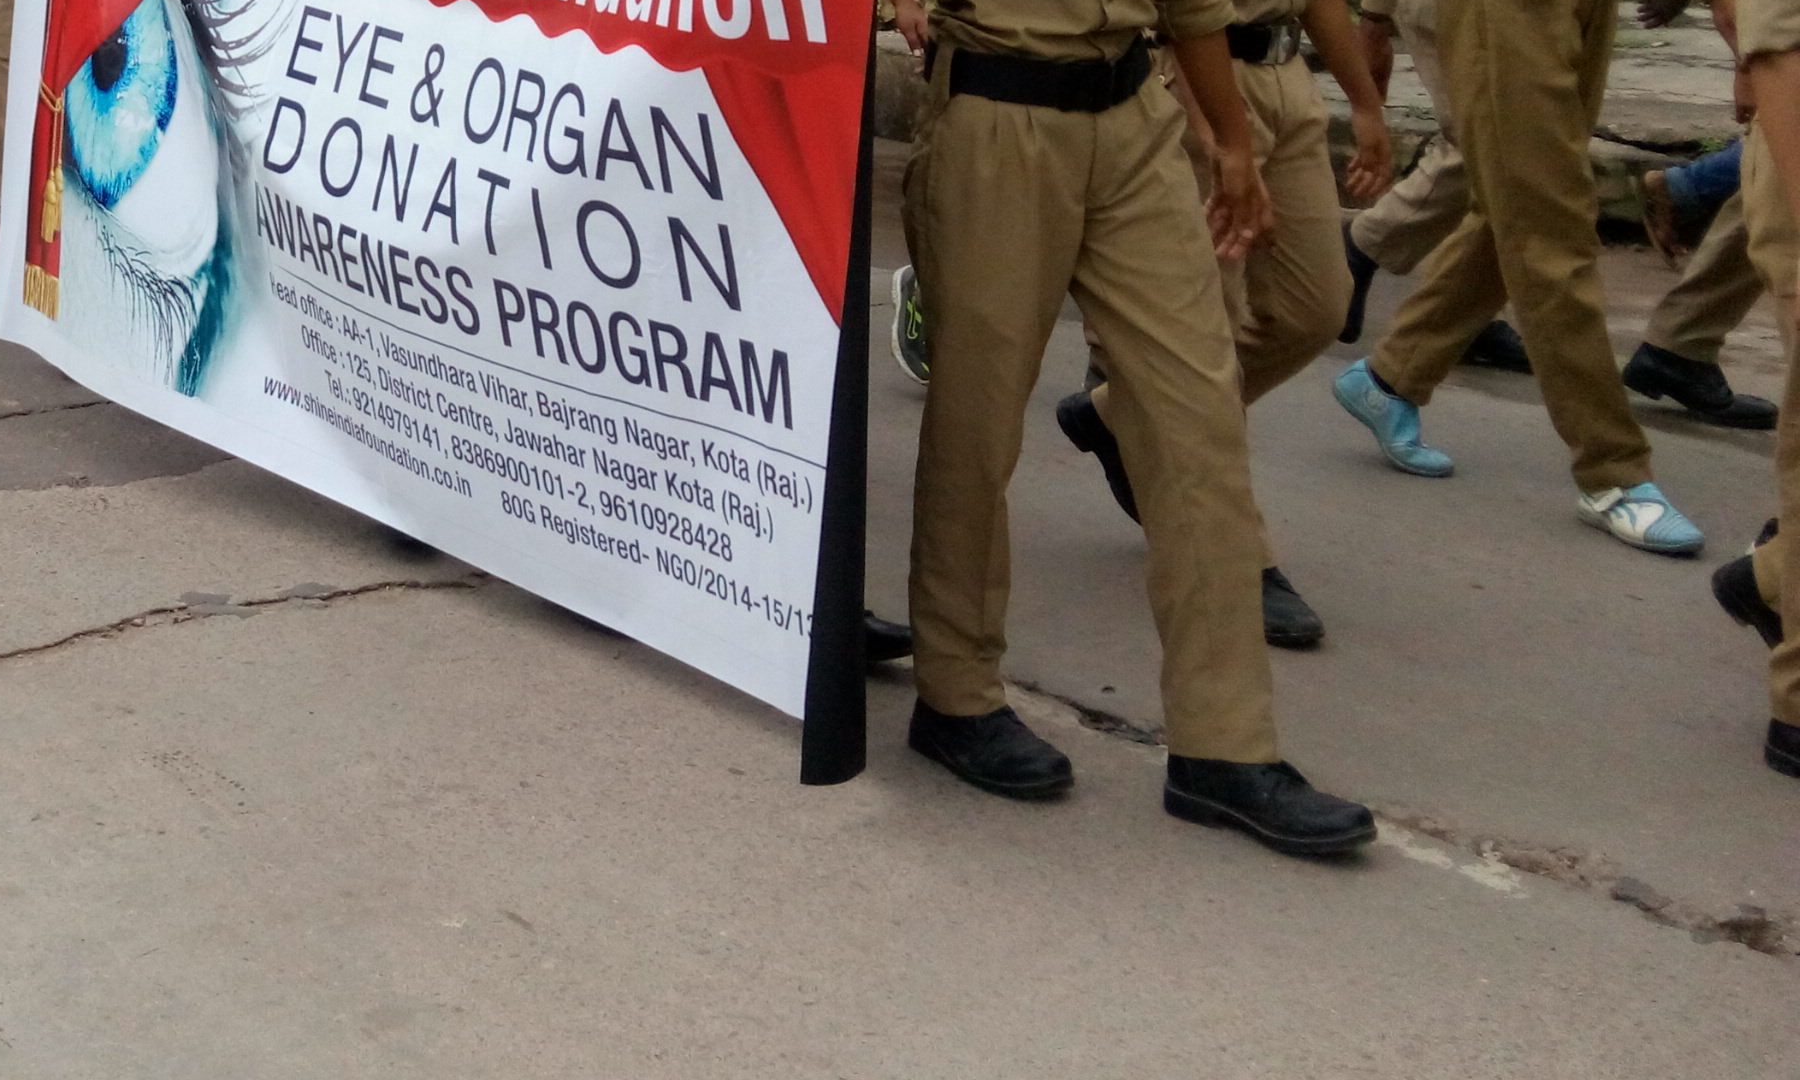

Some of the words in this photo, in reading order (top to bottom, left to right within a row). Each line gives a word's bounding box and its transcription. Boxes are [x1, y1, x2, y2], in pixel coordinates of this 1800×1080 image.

[262, 96, 743, 313] DONATION
[285, 5, 404, 109] EYE
[409, 42, 446, 128] &
[463, 56, 724, 201] ORGAN
[254, 180, 481, 336] AWARENESS
[492, 277, 796, 432] PROGRAM
[300, 292, 334, 330] office
[380, 331, 478, 394] Vasundhara
[478, 370, 534, 417] Vihar,
[536, 390, 619, 445] Bajrang
[623, 416, 697, 468] Nagar,
[701, 438, 751, 484] Kota
[756, 459, 813, 514] (Raj.)
[263, 375, 473, 498] www.shineindiafoundation.co.in
[301, 324, 338, 364] Office
[377, 366, 434, 412] District
[436, 392, 500, 443] Centre,
[503, 418, 586, 469] Jawahar
[592, 447, 658, 491] Nagar
[664, 469, 716, 513] Kota
[721, 489, 775, 544] (Raj.)
[500, 490, 537, 524] 80G
[539, 504, 650, 565] Registered-
[599, 490, 733, 562] 9610928428
